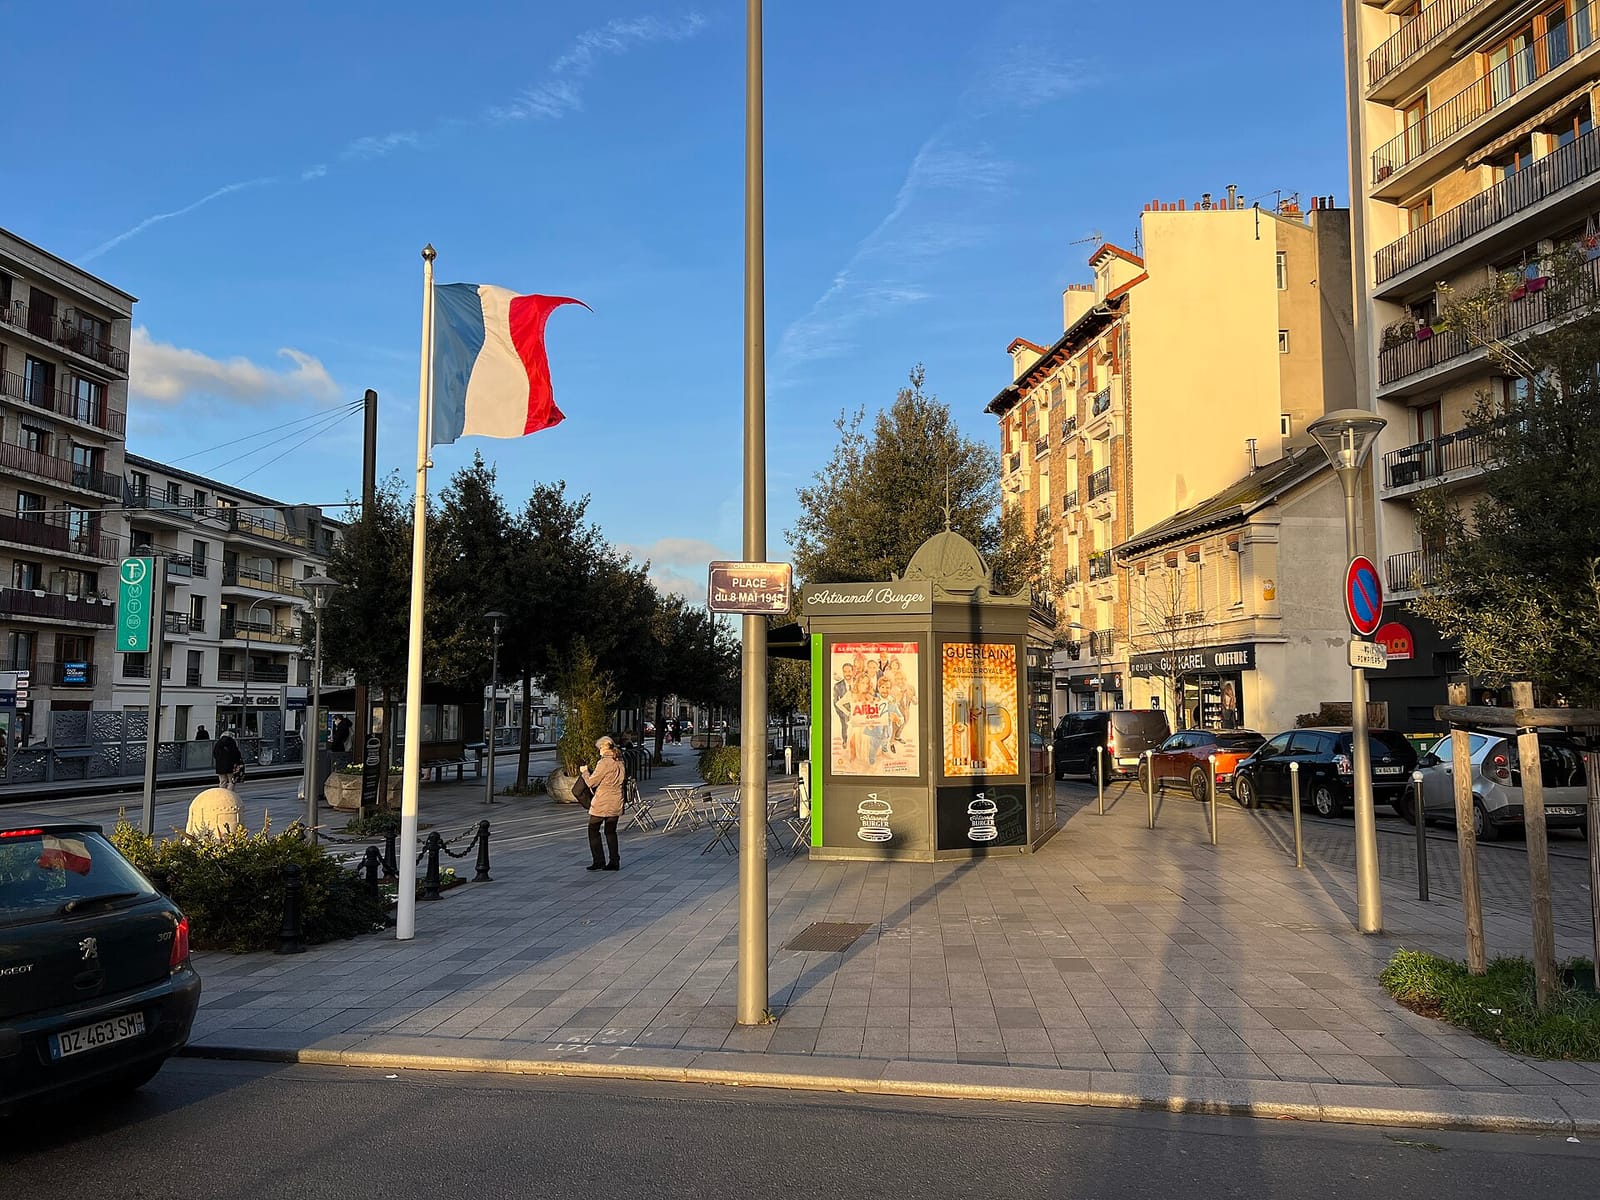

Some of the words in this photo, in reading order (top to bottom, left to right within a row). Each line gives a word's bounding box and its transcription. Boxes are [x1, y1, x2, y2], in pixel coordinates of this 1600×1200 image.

[126, 563, 139, 579] T
[732, 578, 767, 588] PLACE
[714, 592, 728, 602] du
[730, 592, 737, 602] 8
[738, 592, 758, 603] MAI
[760, 592, 783, 603] 1945
[807, 588, 874, 605] Artisanal
[875, 587, 926, 610] Burger
[946, 647, 1009, 660] GUERLAIN
[1178, 654, 1206, 669] KAREL
[1214, 650, 1249, 666] COIFFURE
[853, 704, 879, 716] Alibi
[879, 702, 888, 717] 2
[971, 819, 995, 827] BURGER
[157, 931, 172, 943] 307
[60, 1016, 137, 1054] DZ-463-SM
